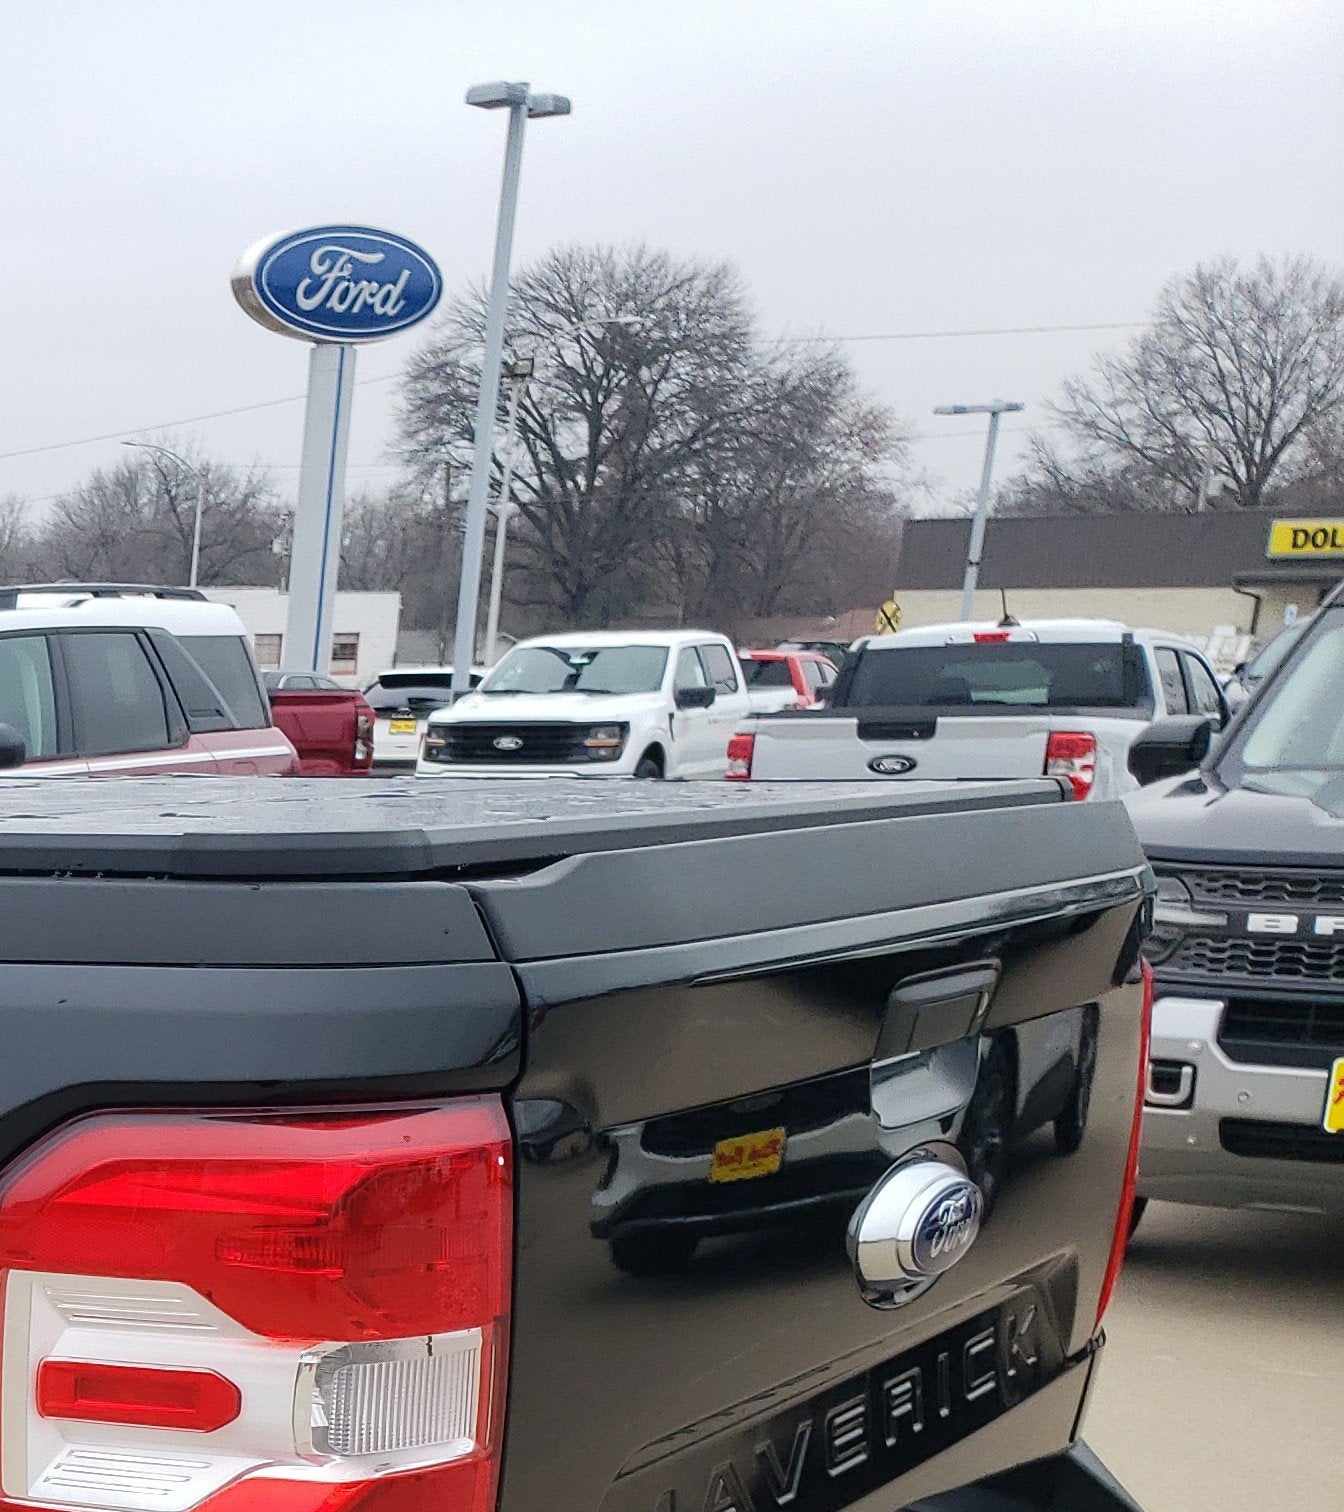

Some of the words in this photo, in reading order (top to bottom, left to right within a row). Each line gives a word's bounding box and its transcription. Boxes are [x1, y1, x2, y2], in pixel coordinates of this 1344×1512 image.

[296, 245, 411, 316] Ford
[1292, 528, 1344, 549] DOL
[929, 1190, 971, 1259] Ford
